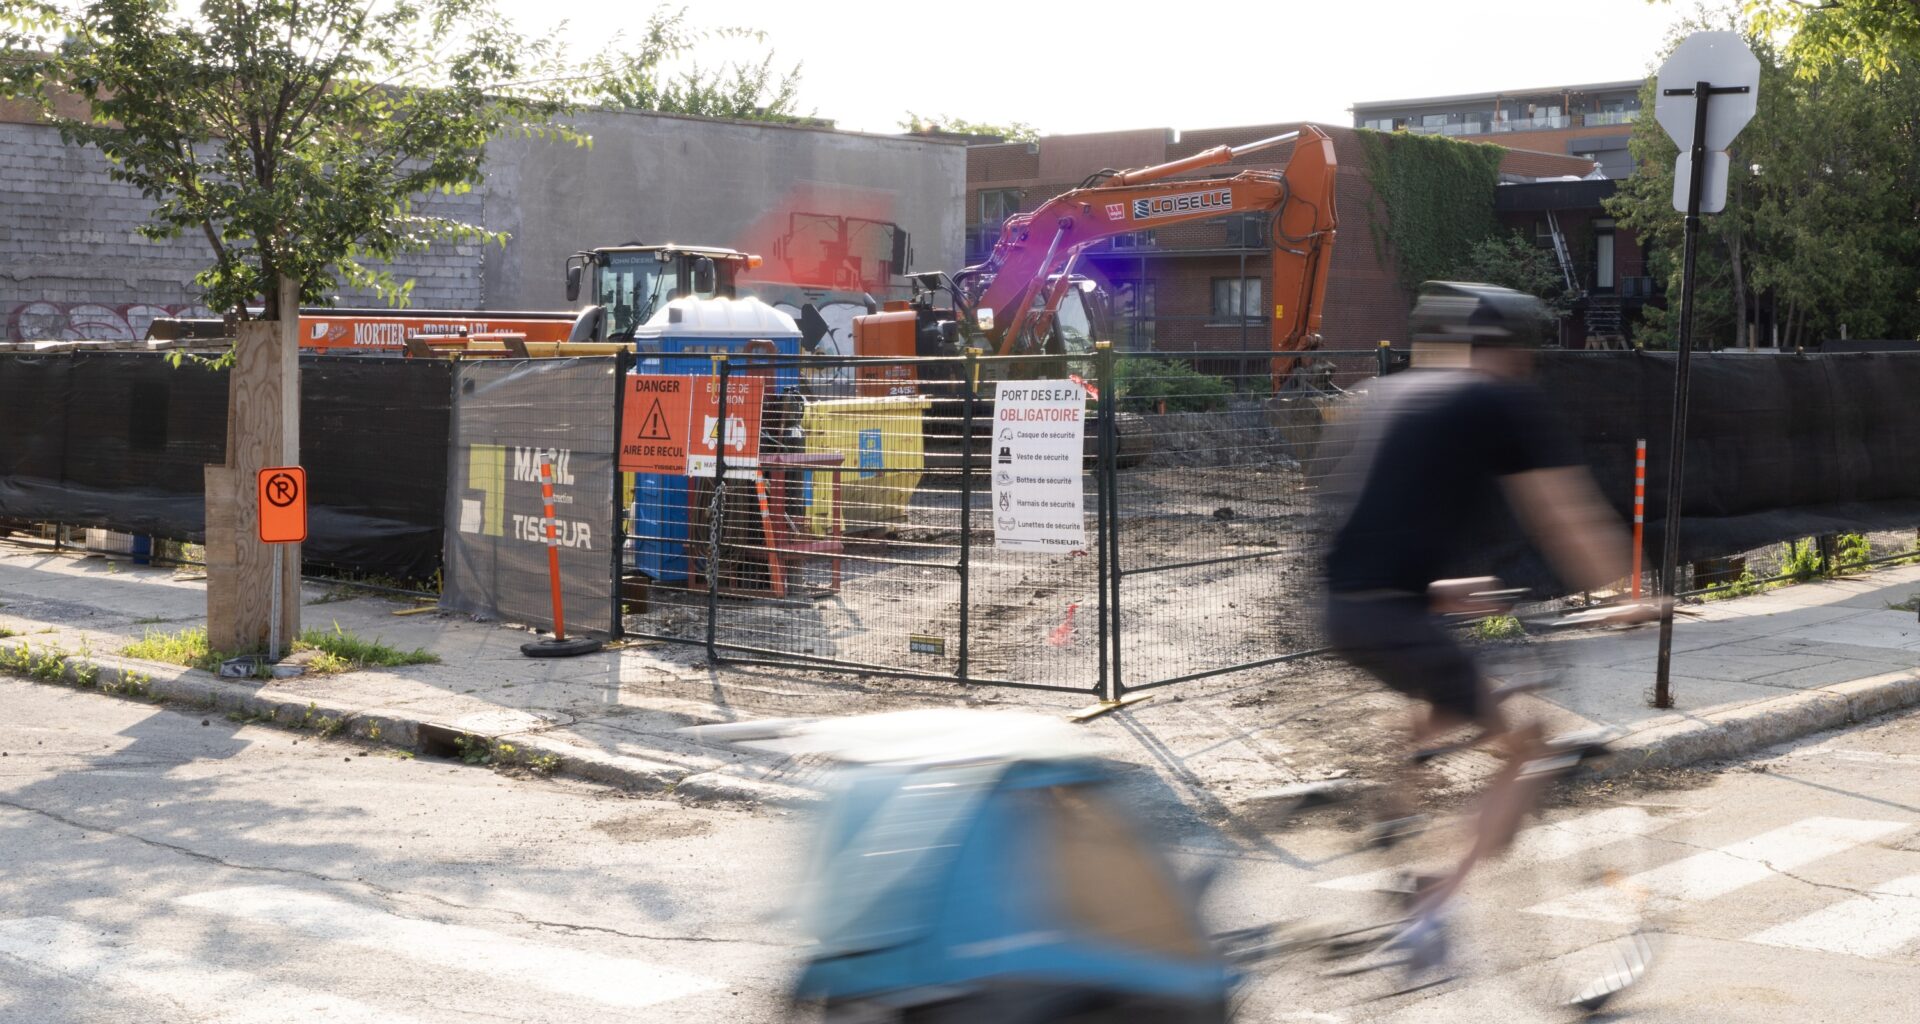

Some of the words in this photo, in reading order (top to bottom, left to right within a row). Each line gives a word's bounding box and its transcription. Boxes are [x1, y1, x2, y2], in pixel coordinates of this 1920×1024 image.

[1151, 192, 1231, 213] LOISELLE
[354, 322, 406, 345] MORTIER
[635, 379, 681, 393] DANGER
[738, 383, 750, 394] DE
[1001, 389, 1029, 401] PORT
[1030, 389, 1052, 401] DES
[1054, 389, 1081, 401] E.P.I.
[1000, 408, 1080, 422] OBLIGATOIRE
[1016, 431, 1040, 439] Casque
[1040, 431, 1049, 439] de
[1049, 431, 1076, 439] sécurité
[623, 444, 643, 456] AIRE
[643, 445, 656, 456] DE
[656, 446, 685, 458] RECUL
[1016, 452, 1034, 461] Veste
[1034, 452, 1043, 461] de
[1043, 453, 1069, 461] sécurité
[1016, 476, 1037, 484] Bottes
[1037, 476, 1046, 484] de
[1046, 477, 1072, 485] sécurité
[1016, 499, 1040, 508] Harnais
[1040, 499, 1049, 508] de
[1049, 500, 1076, 508] sécurité
[1017, 521, 1045, 529] Lunettes
[1045, 521, 1054, 530] de
[1054, 522, 1080, 530] sécurité
[512, 514, 592, 550] TISSEUR
[1040, 538, 1080, 546] TISSEUR
